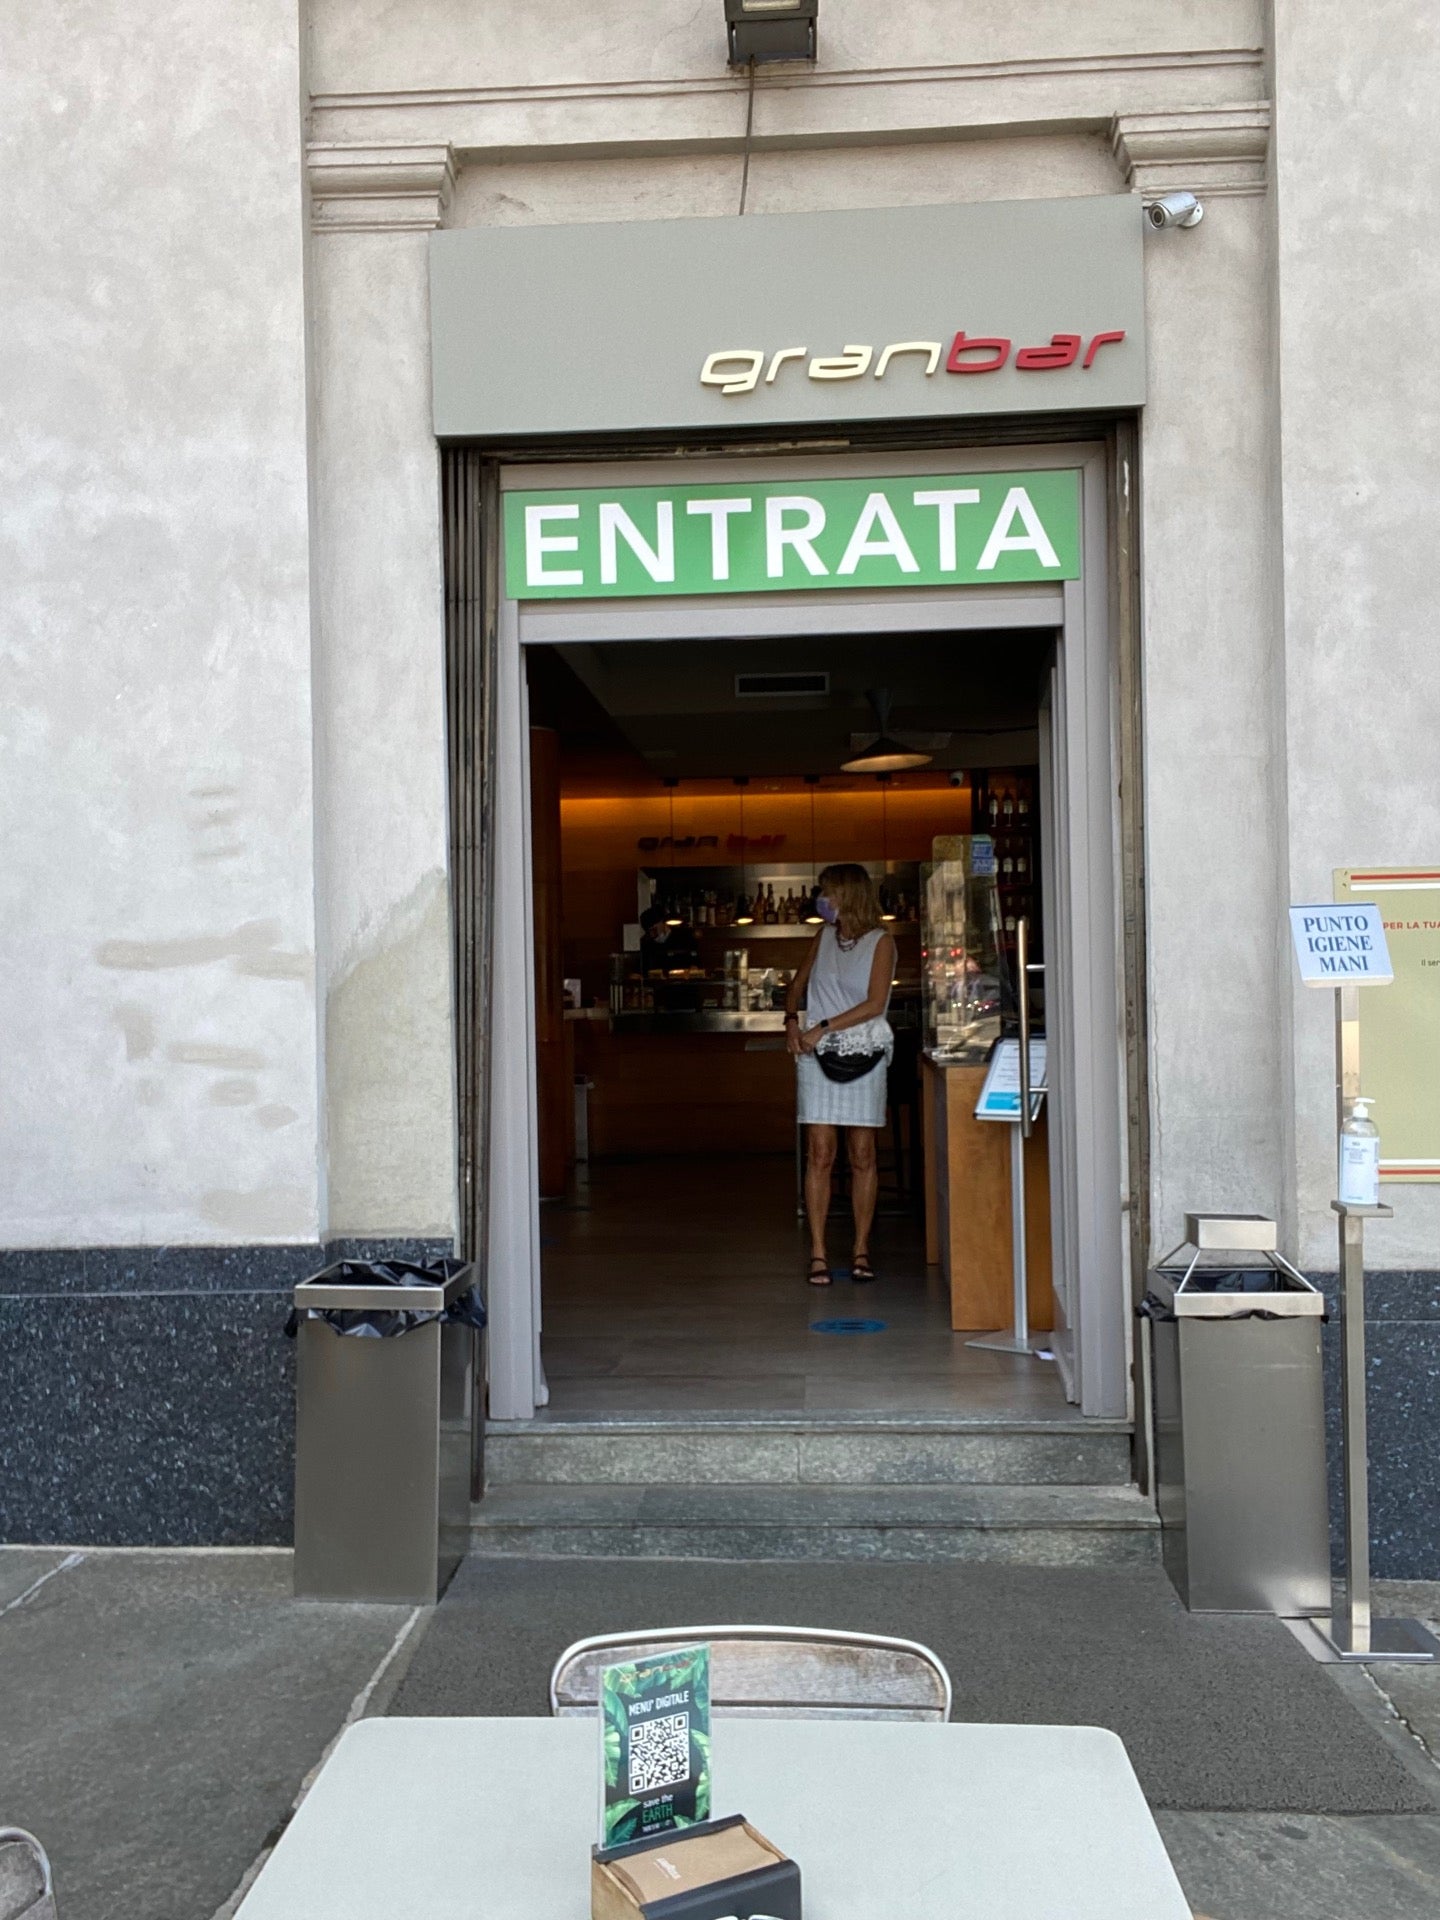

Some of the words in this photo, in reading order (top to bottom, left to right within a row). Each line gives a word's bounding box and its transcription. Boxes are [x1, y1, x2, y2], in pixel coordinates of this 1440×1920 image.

[525, 486, 1062, 587] ENTRATA
[1303, 915, 1369, 933] PUNTO
[1383, 921, 1404, 930] PER
[1406, 921, 1420, 930] LA
[1307, 935, 1374, 953] IGIENE
[1319, 955, 1369, 973] MANI
[655, 1690, 690, 1710] DIGITALE
[642, 1803, 673, 1824] EARTH
